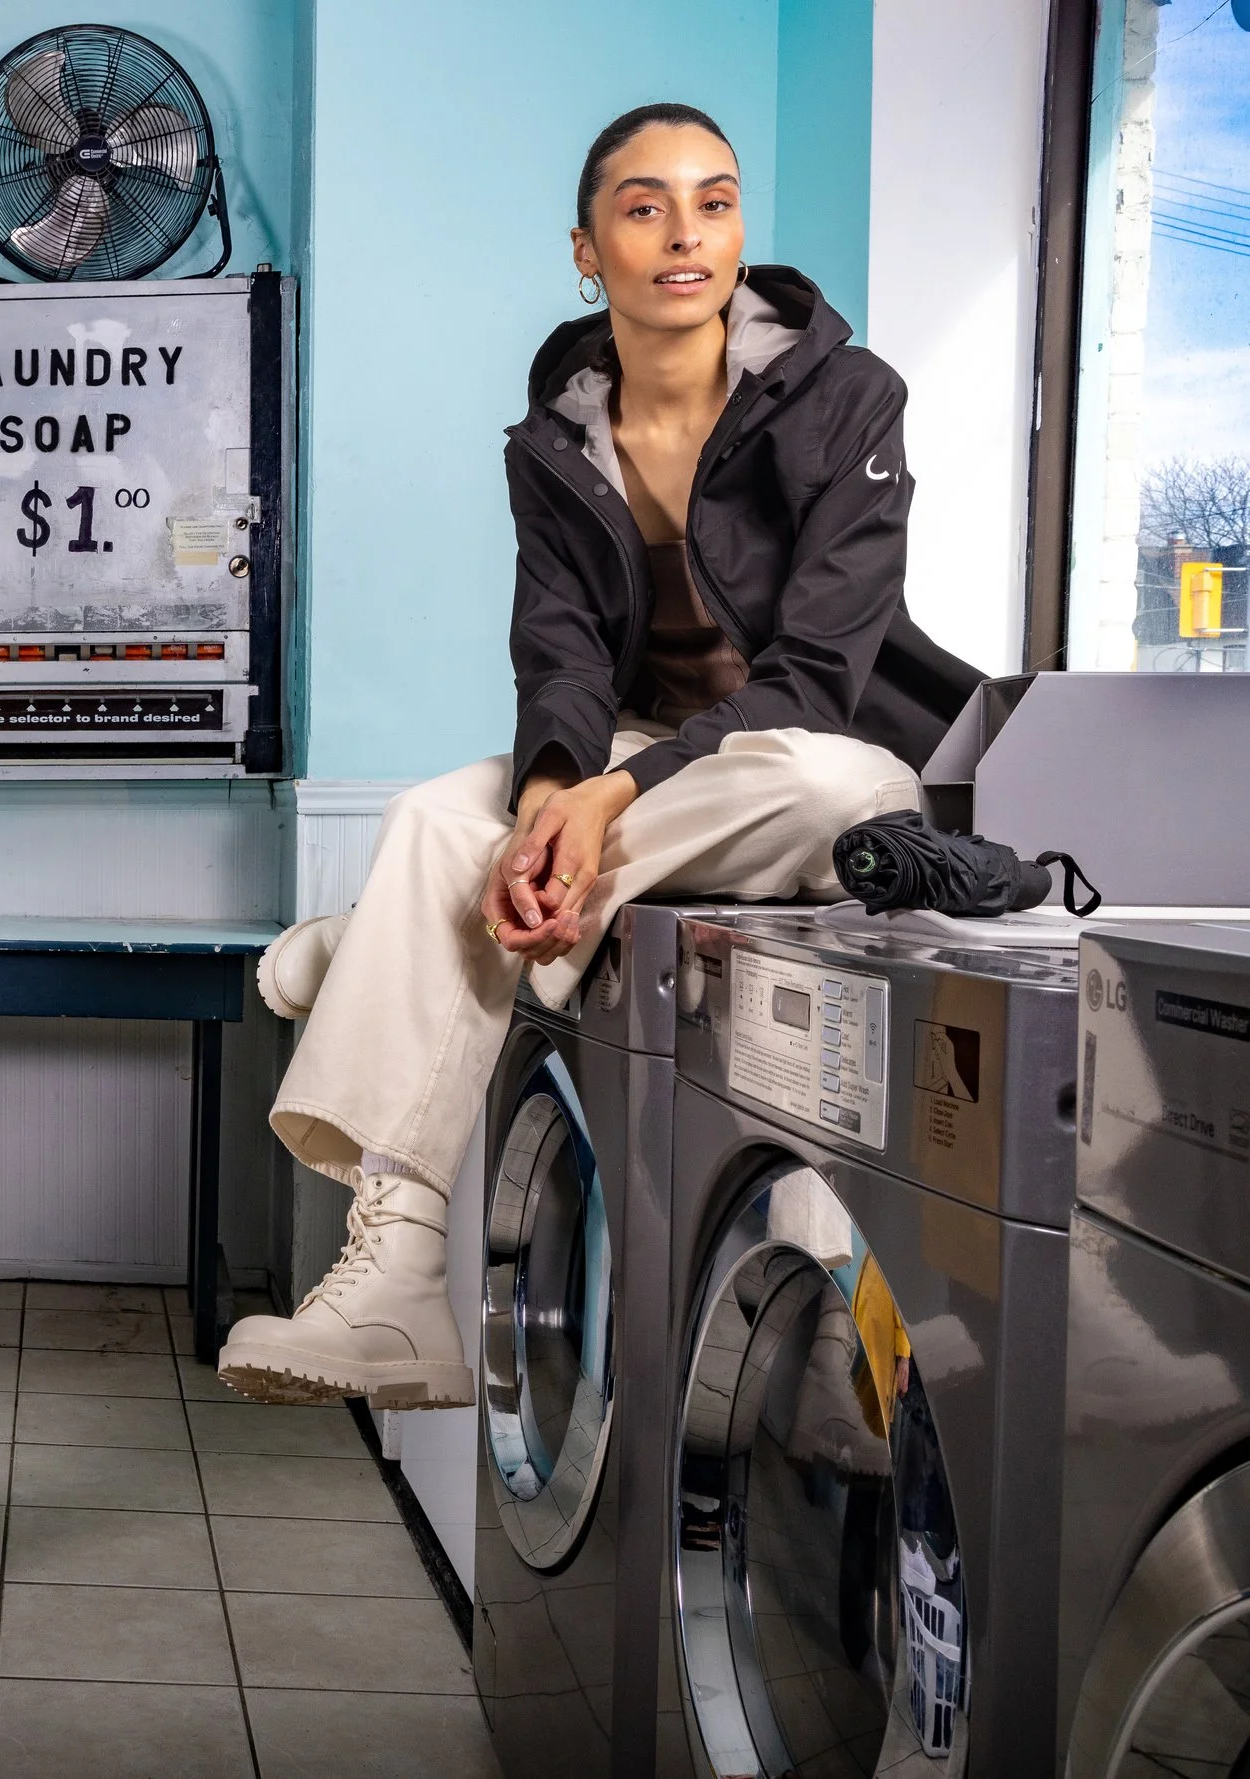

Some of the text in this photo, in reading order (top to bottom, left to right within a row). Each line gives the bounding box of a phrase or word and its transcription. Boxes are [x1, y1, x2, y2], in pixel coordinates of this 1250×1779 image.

[0, 413, 132, 453] SOAP
[9, 714, 70, 724] selector
[76, 714, 90, 722] to
[94, 714, 138, 722] brand
[143, 714, 200, 722] desired
[1106, 979, 1127, 1012] LG
[1157, 998, 1250, 1033] Commercial Washer
[1162, 1104, 1188, 1129] Direct
[1191, 1113, 1215, 1138] Drive
